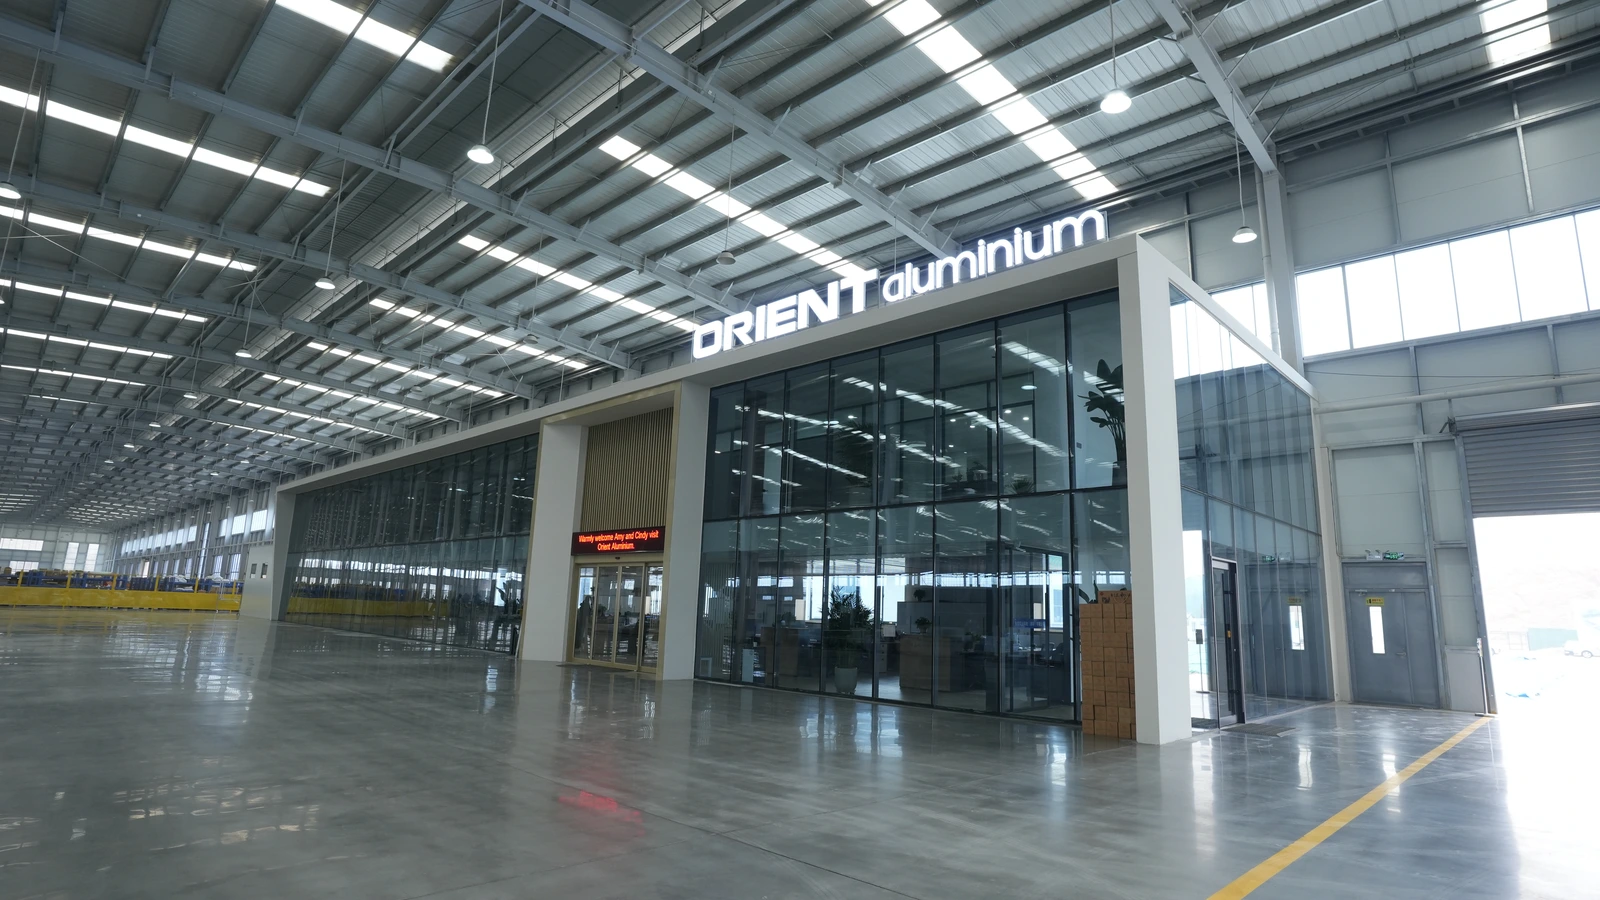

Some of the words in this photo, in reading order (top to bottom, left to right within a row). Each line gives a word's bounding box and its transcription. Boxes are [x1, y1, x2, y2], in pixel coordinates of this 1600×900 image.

[692, 268, 879, 359] ORIENT
[882, 209, 1107, 302] aluminium
[578, 535, 594, 543] Warmly
[614, 533, 625, 541] Amy
[625, 532, 634, 540] and
[635, 530, 648, 540] Cindy
[649, 530, 659, 538] visit
